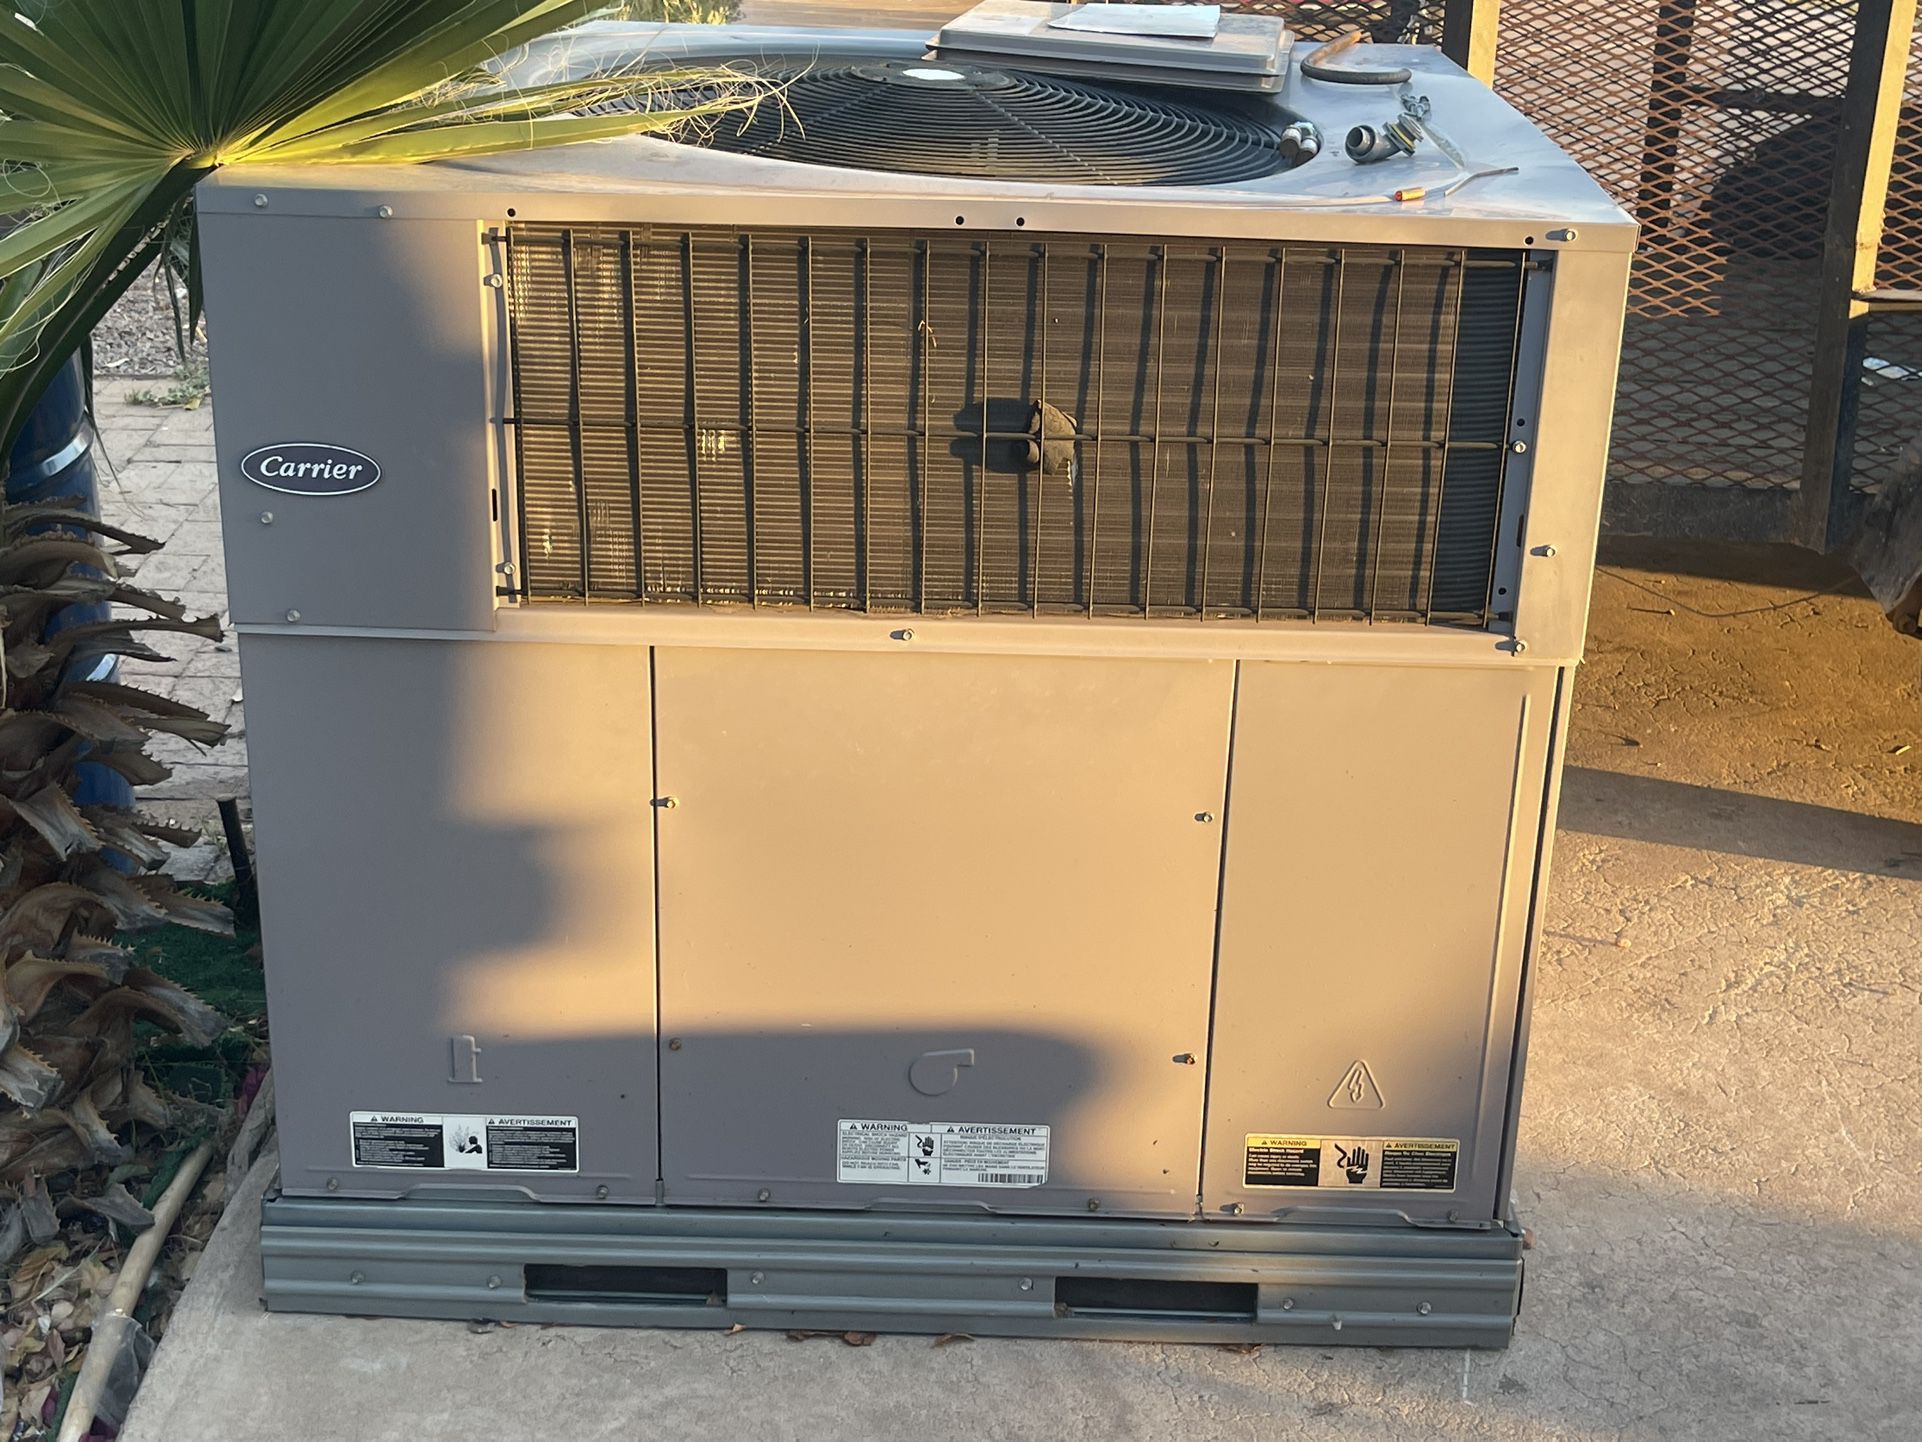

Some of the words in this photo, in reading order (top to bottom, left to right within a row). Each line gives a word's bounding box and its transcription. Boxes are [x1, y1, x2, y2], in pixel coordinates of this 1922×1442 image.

[260, 455, 363, 480] Carrier
[381, 1115, 424, 1123] WARNING
[498, 1118, 572, 1126] AVERTISSEMENT
[860, 1123, 908, 1131] WARNING
[958, 1126, 1036, 1135] AVERTISSEMENT
